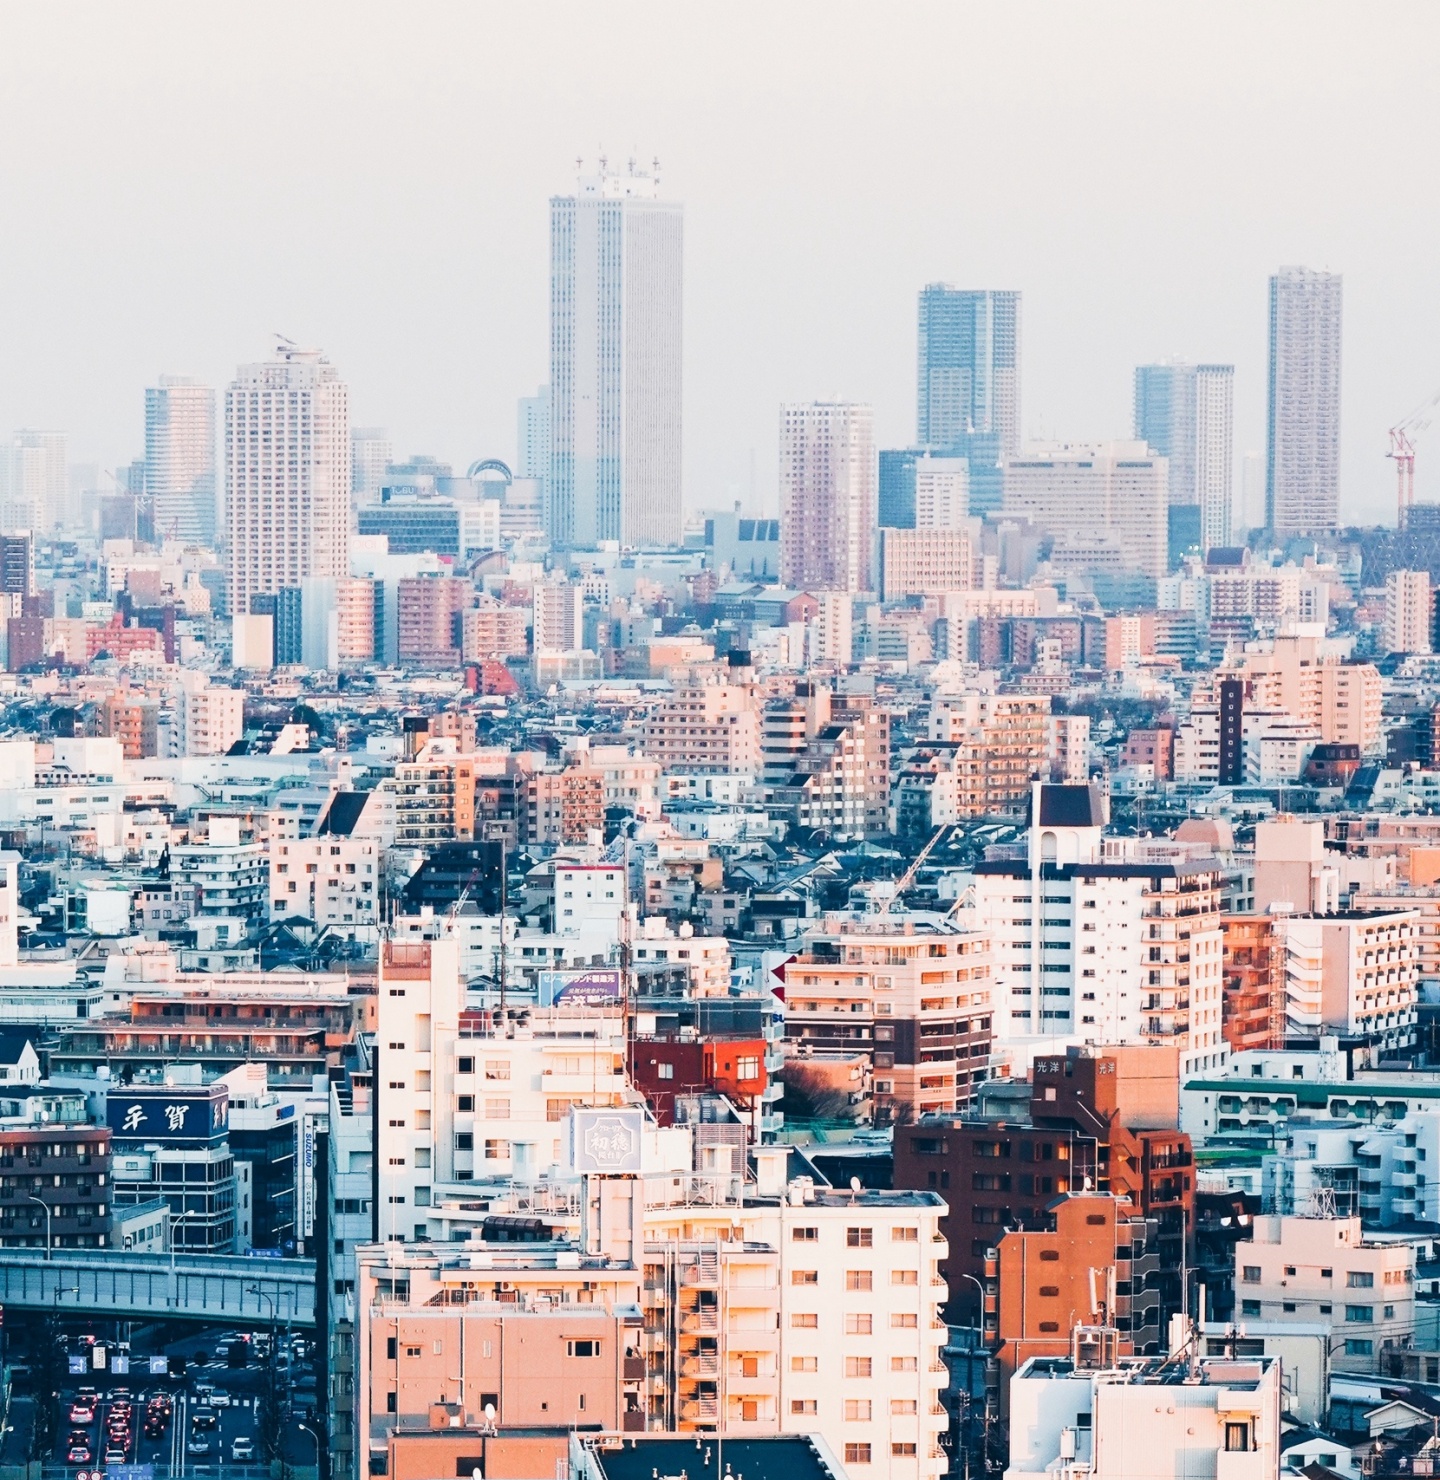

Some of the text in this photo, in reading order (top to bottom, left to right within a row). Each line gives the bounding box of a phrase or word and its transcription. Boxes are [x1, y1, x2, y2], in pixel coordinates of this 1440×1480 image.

[1037, 1061, 1060, 1073] 光洋
[1099, 1062, 1116, 1075] 光洋
[122, 1104, 190, 1131] 平賀
[590, 1132, 628, 1151] 初穂
